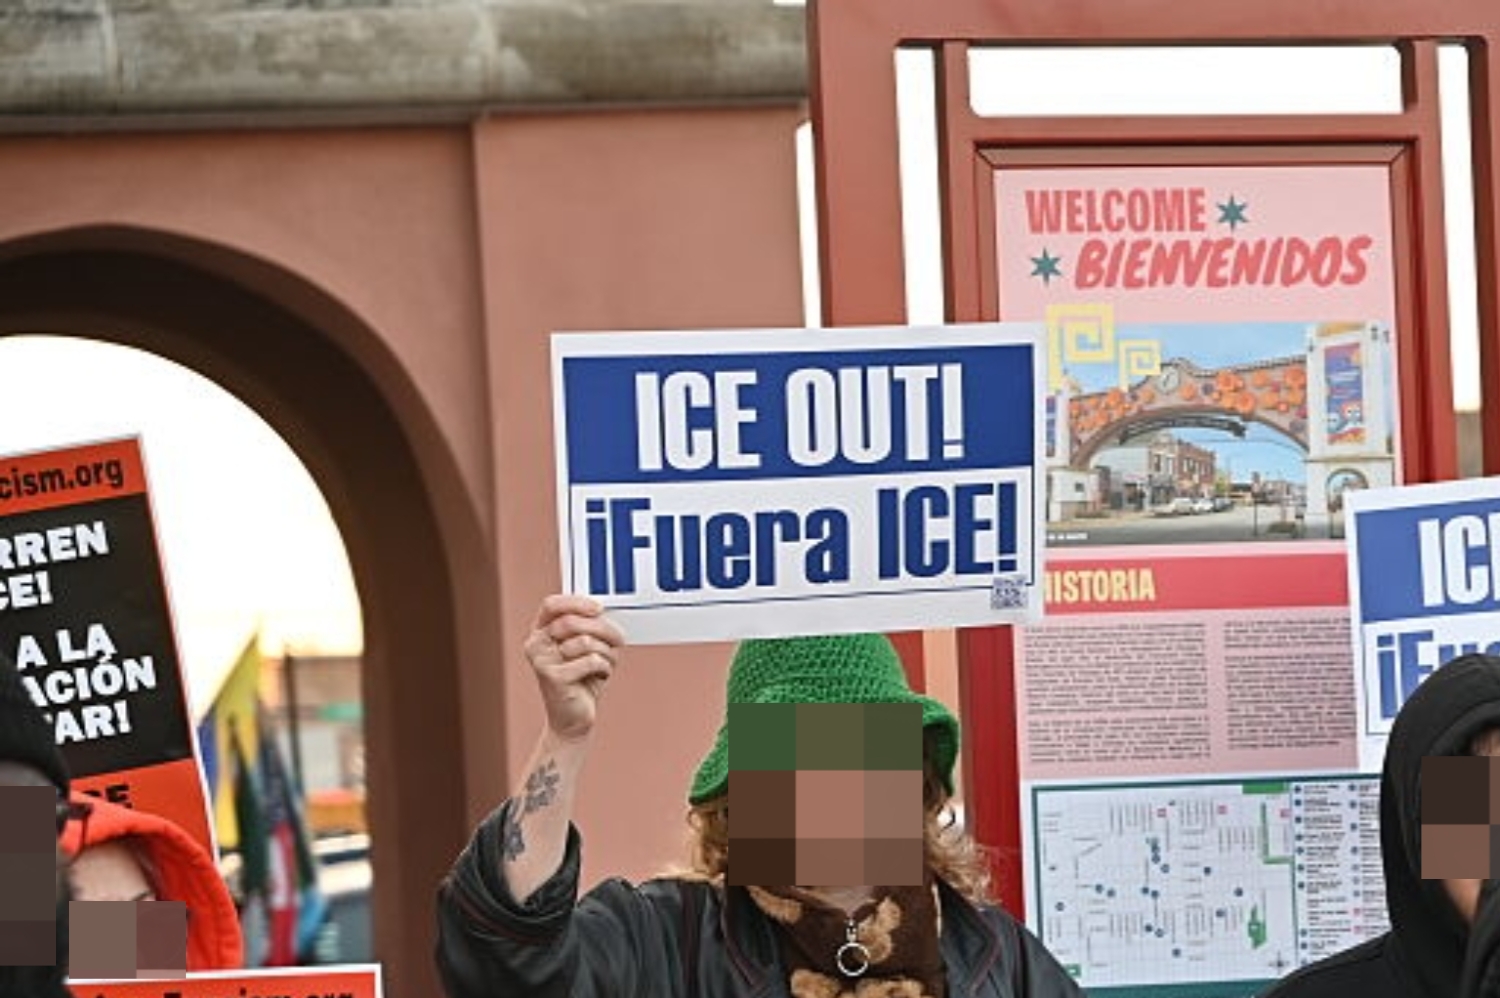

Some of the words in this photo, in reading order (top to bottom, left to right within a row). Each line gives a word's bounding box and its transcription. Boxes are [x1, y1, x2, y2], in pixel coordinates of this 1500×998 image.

[1025, 189, 1206, 234] WELCOME
[1074, 236, 1373, 290] BIENVENIDOS
[635, 370, 760, 470] ICE
[786, 363, 964, 467] OUT!
[877, 482, 1018, 578] ICE!
[16, 634, 48, 671] A
[56, 622, 117, 663] LA
[45, 699, 132, 745] AR!
